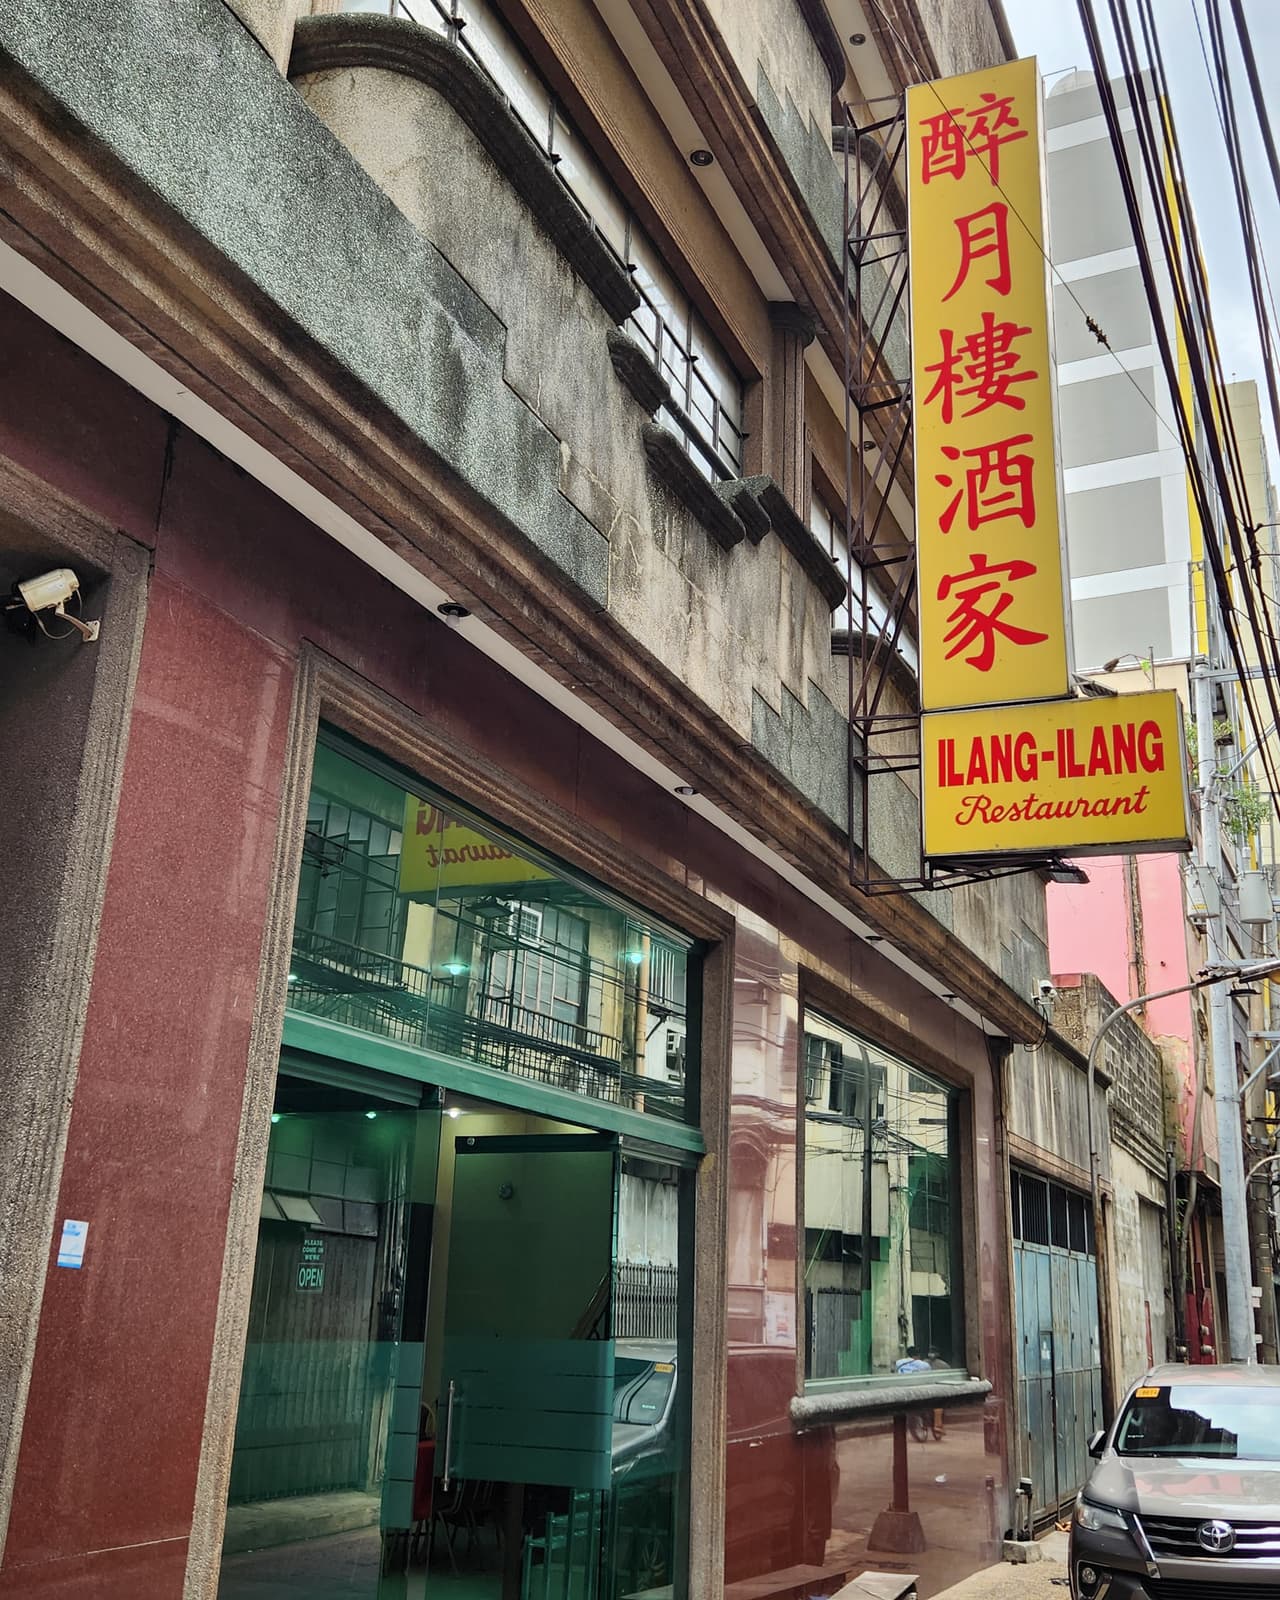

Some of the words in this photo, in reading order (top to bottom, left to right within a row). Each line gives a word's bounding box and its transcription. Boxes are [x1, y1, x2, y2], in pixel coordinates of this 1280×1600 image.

[920, 92, 1049, 673] 醉月樓酒家
[938, 719, 1165, 788] ILANG-ILANG
[955, 785, 1150, 826] Restaurant
[299, 1268, 323, 1287] OPEN
